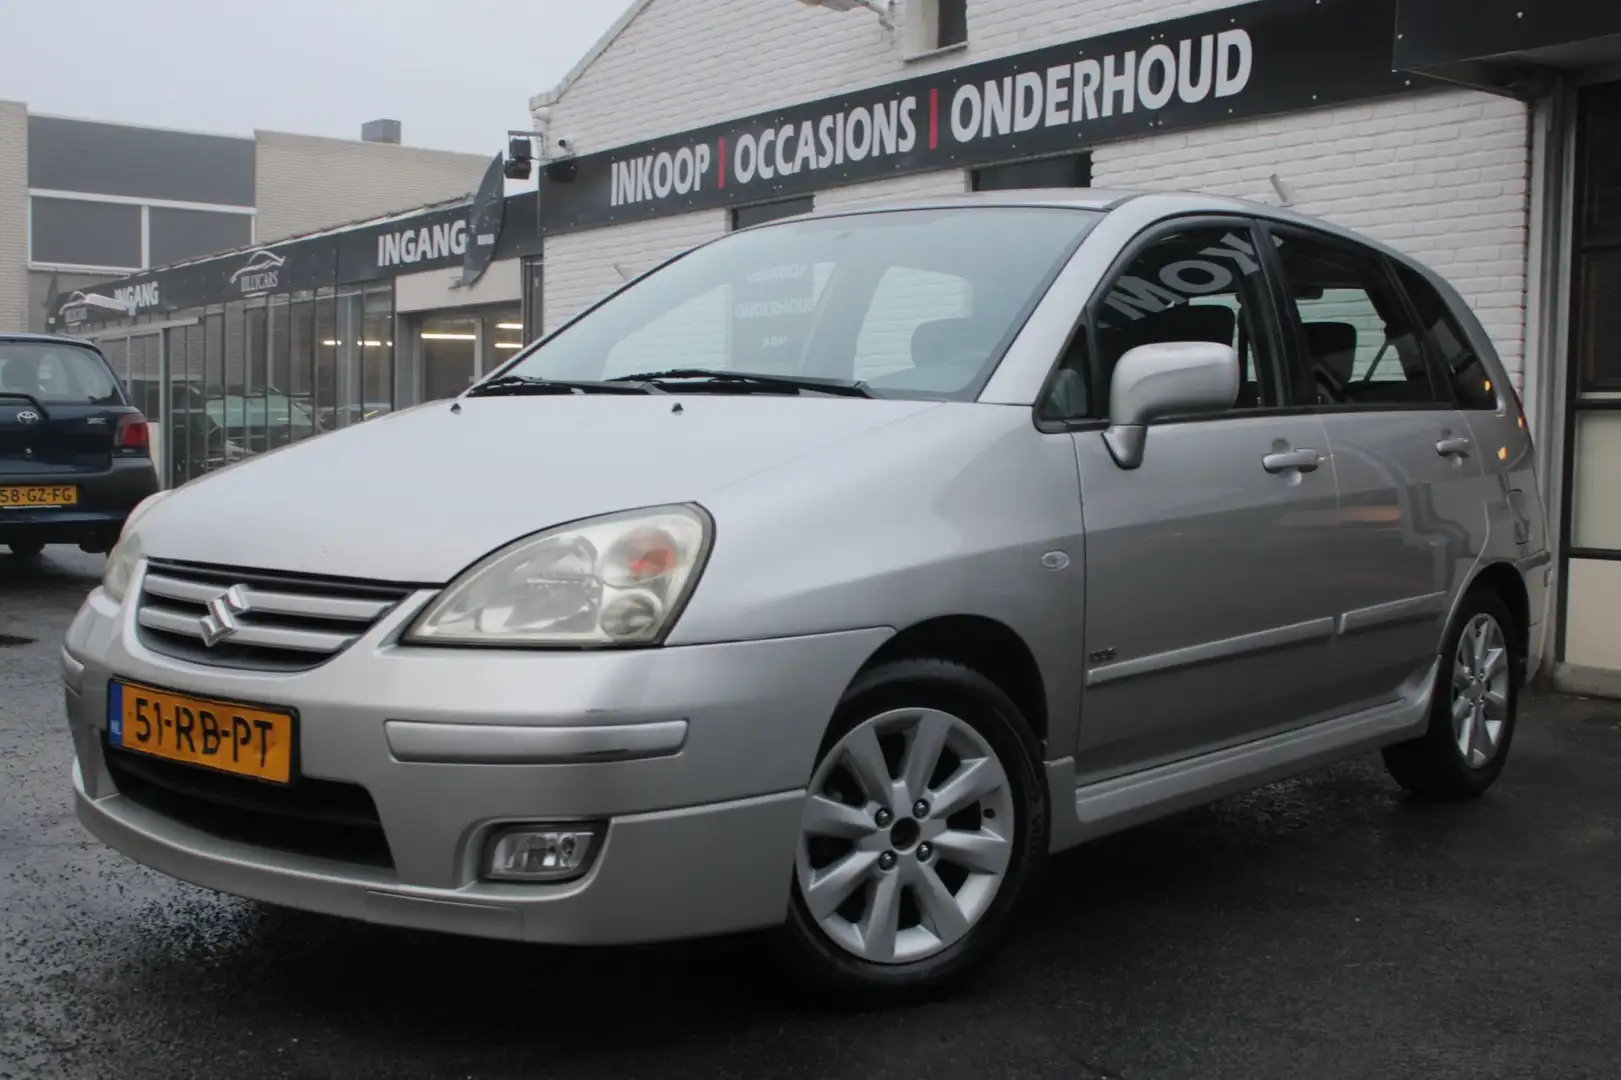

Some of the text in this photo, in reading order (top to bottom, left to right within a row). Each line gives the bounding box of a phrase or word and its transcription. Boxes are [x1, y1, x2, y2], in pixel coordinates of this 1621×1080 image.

[610, 28, 1253, 206] INKOOP OCCASIONS ONDERHOUD
[377, 219, 467, 267] INGANG
[0, 487, 73, 503] 58-GZ-FG
[135, 697, 273, 768] 51-RB-PT
